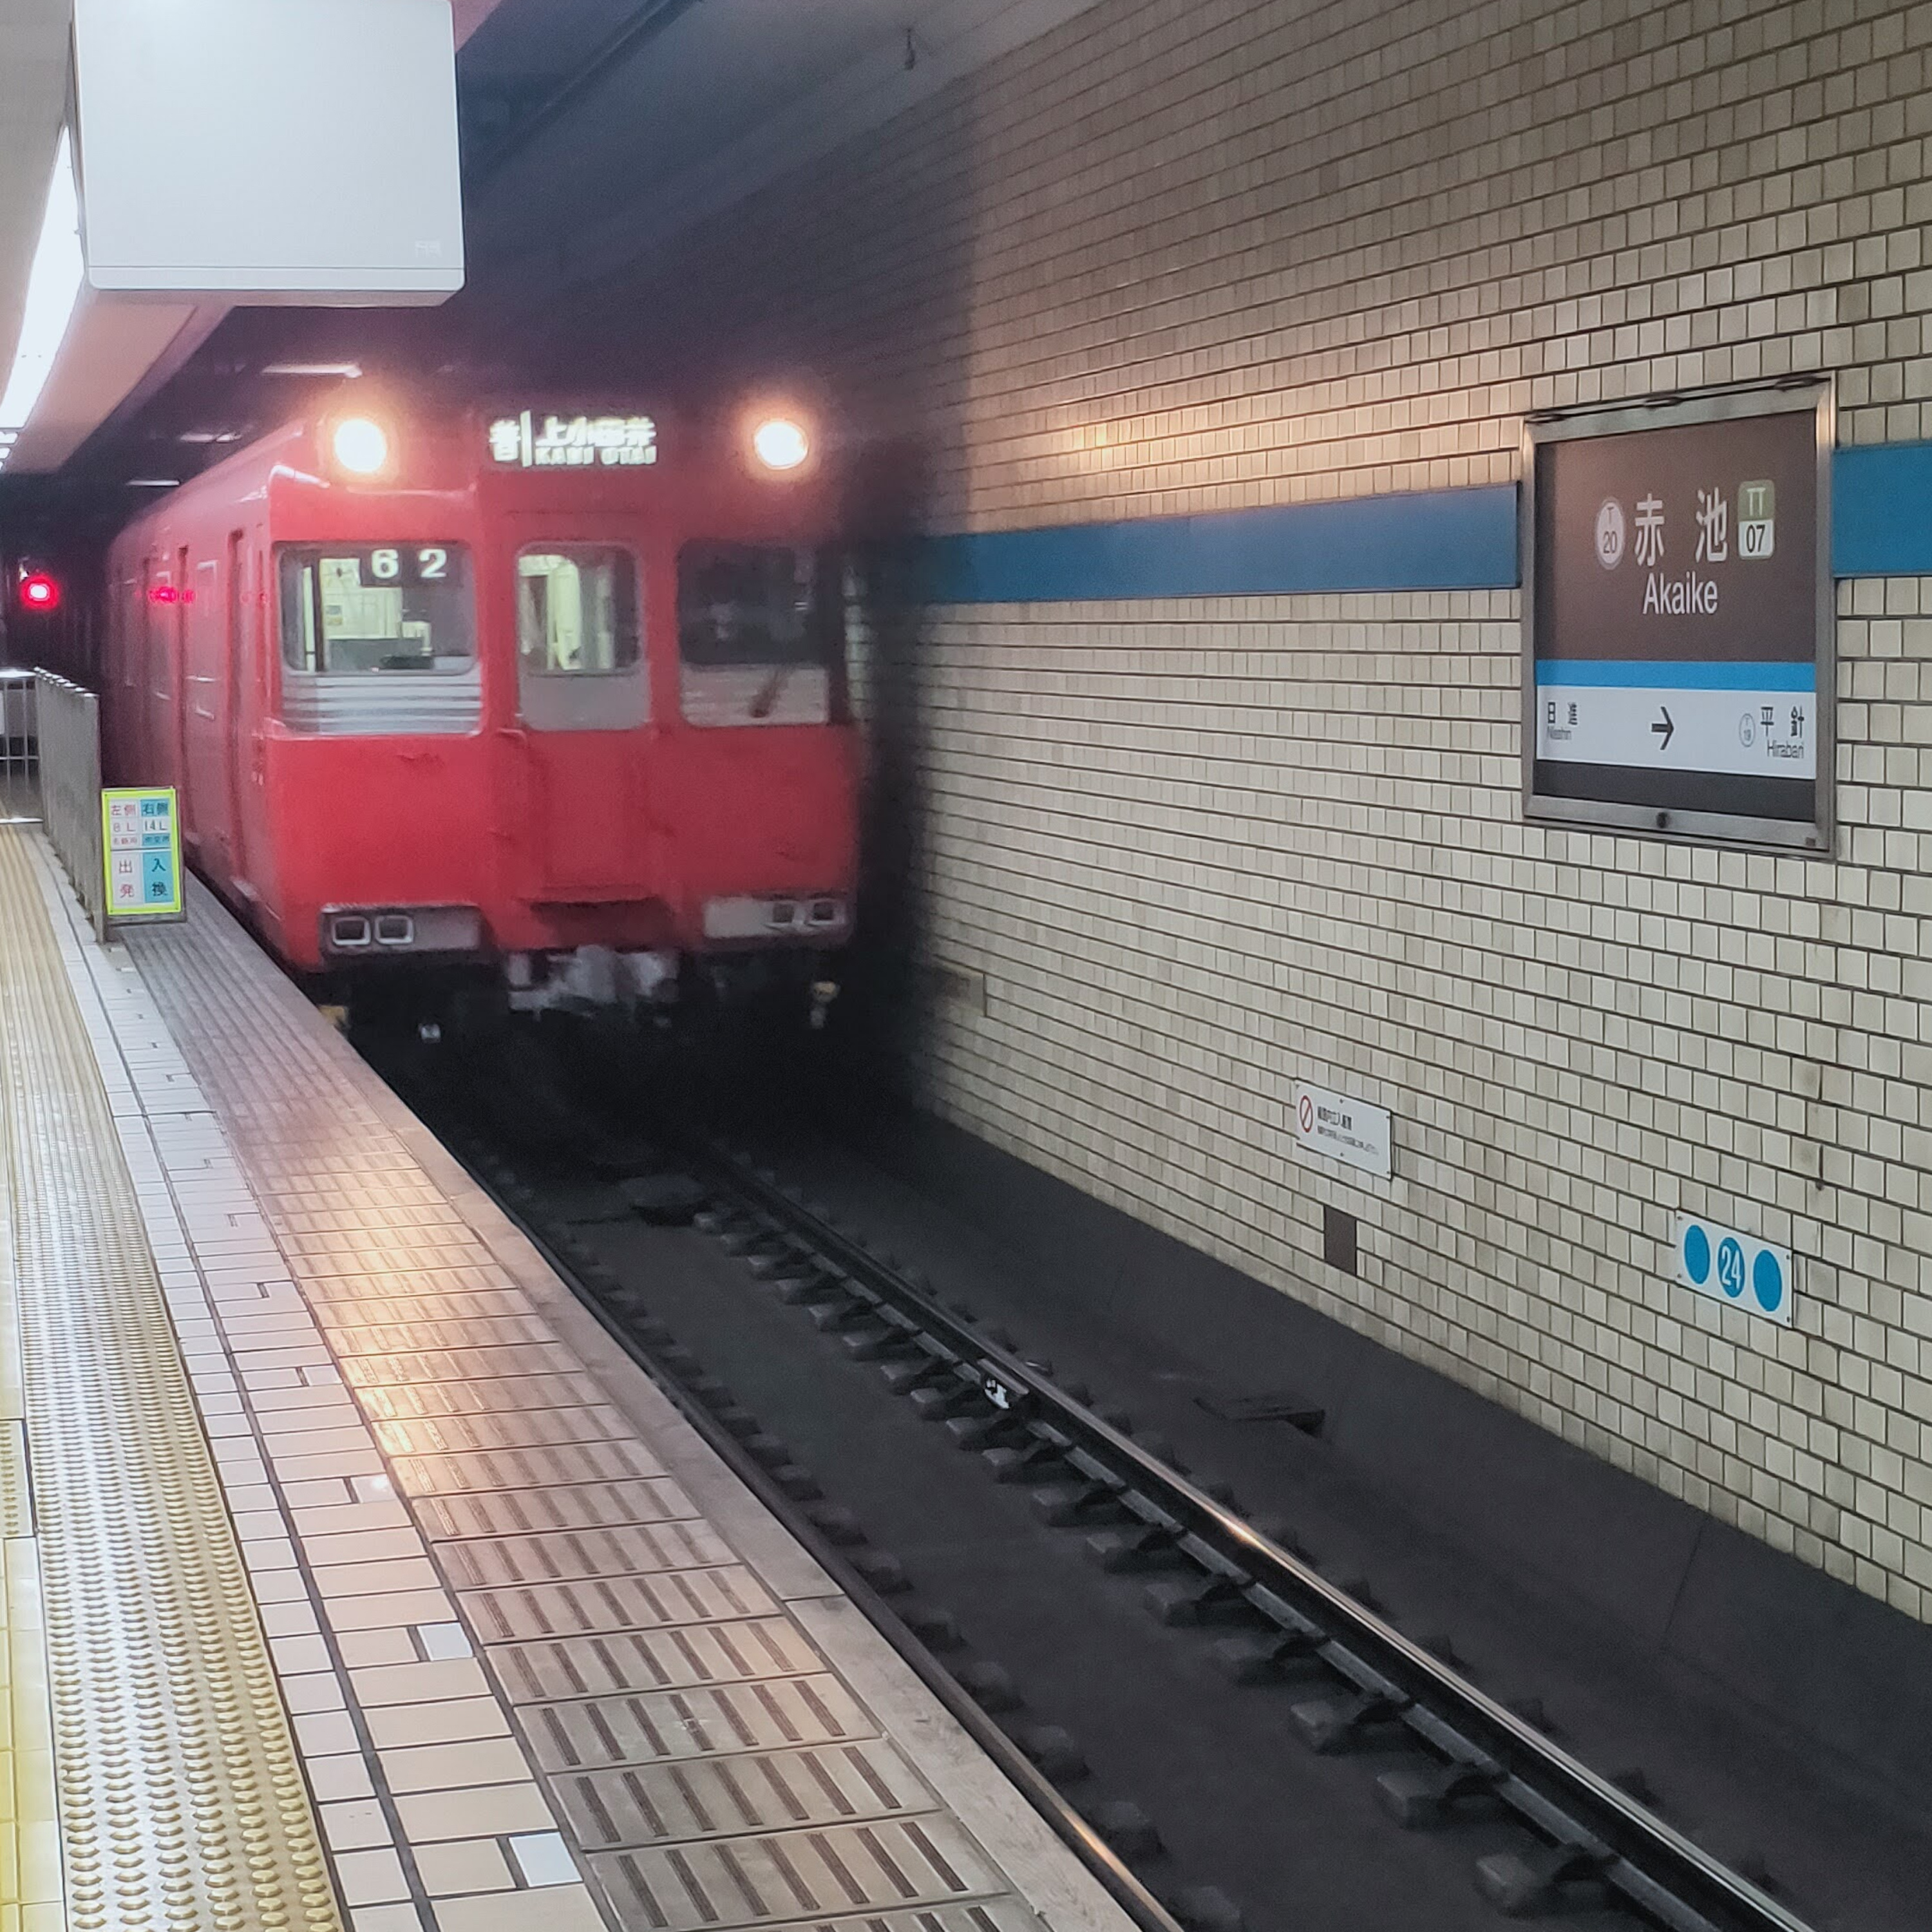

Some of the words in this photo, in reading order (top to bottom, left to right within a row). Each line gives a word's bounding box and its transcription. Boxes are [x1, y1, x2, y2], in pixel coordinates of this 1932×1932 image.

[1603, 530, 1618, 554] 20
[1634, 487, 1728, 566] 赤池
[1746, 524, 1766, 553] 07
[1642, 570, 1719, 614] Akaike
[1721, 1245, 1742, 1289] 24
